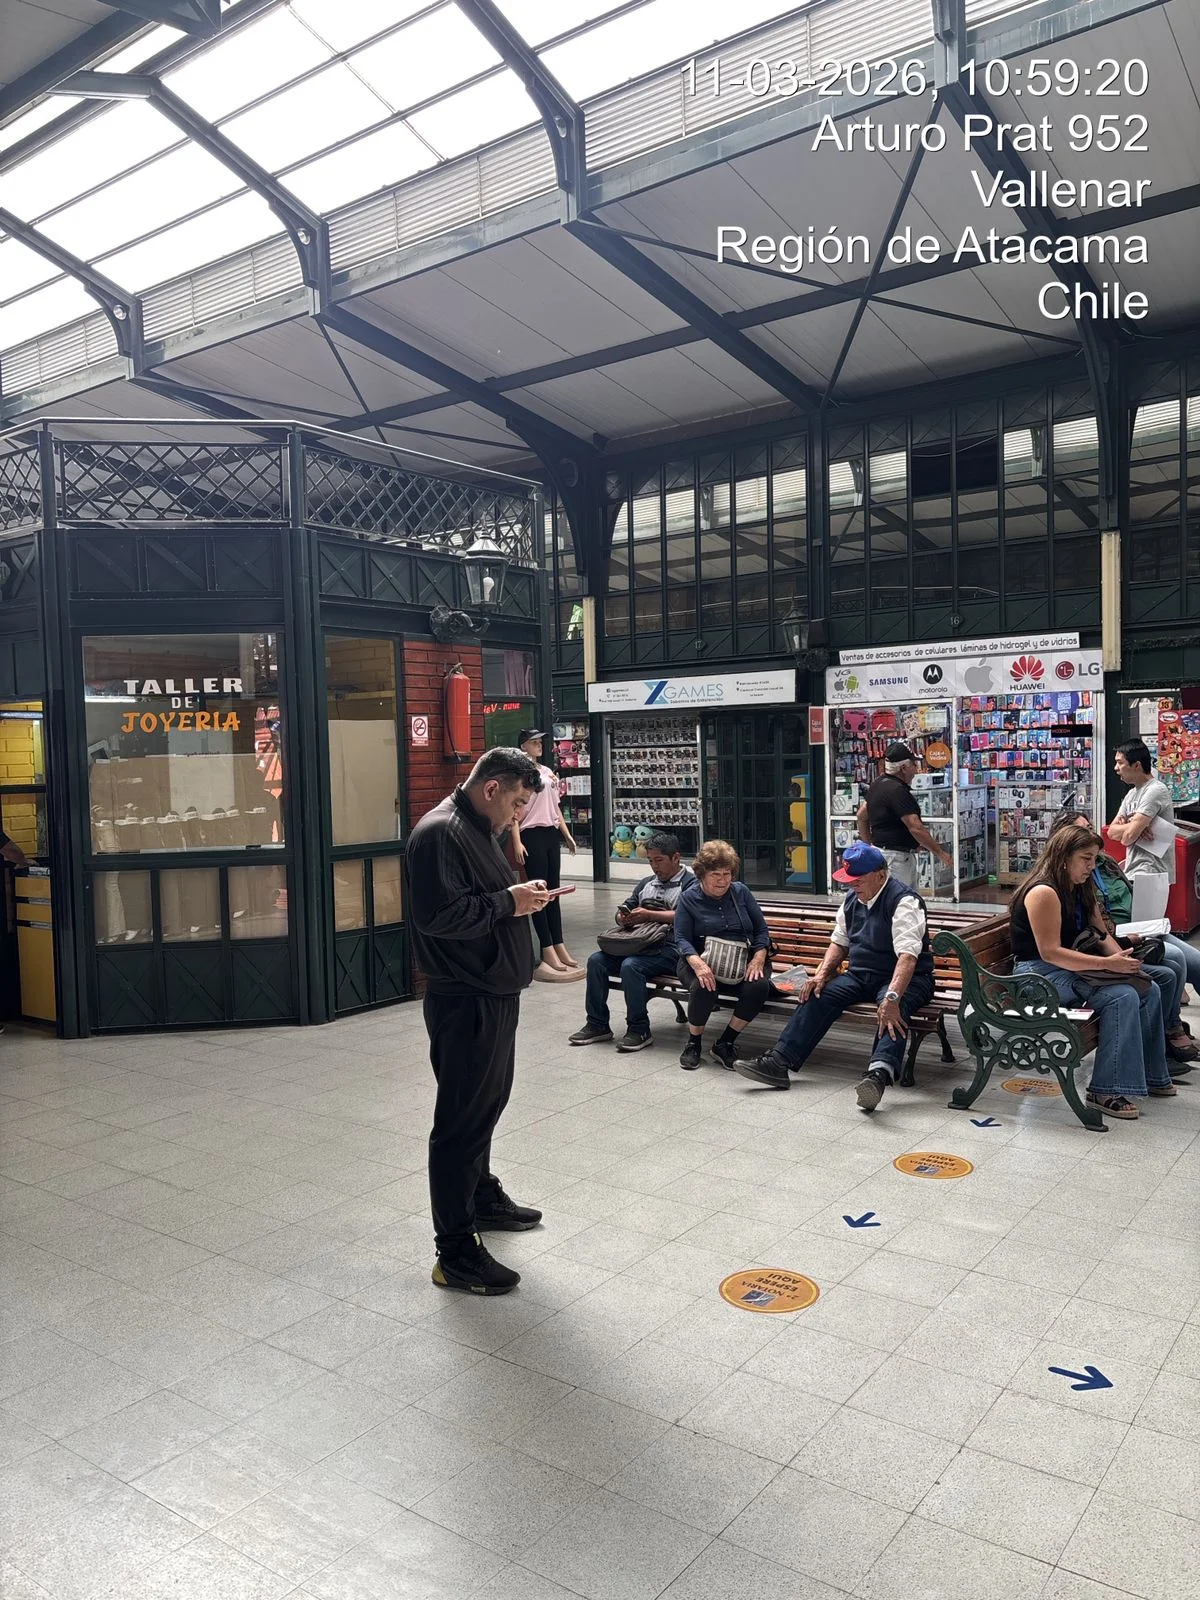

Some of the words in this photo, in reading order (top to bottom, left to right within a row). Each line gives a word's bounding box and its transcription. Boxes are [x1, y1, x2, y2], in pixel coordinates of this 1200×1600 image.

[950, 616, 960, 625] 16
[841, 653, 864, 661] Ventas
[866, 652, 873, 660] de
[875, 649, 911, 659] accesorios
[915, 648, 924, 656] de
[925, 646, 957, 655] celulares
[989, 642, 998, 650] de
[1000, 639, 1031, 650] hidrogel
[1033, 641, 1038, 649] y
[1039, 638, 1049, 647] de
[1051, 637, 1078, 646] vidrios
[1078, 662, 1100, 676] LG
[123, 678, 243, 695] TALLER
[869, 676, 909, 687] SAMSUNG
[1009, 682, 1046, 691] HUAWEI
[918, 686, 948, 694] motorola
[171, 696, 194, 709] DE
[120, 711, 240, 733] JOYERIA
[755, 1277, 800, 1292] ESPERE
[767, 1273, 802, 1285] AQUI
[741, 1281, 785, 1296] NOTARIA
